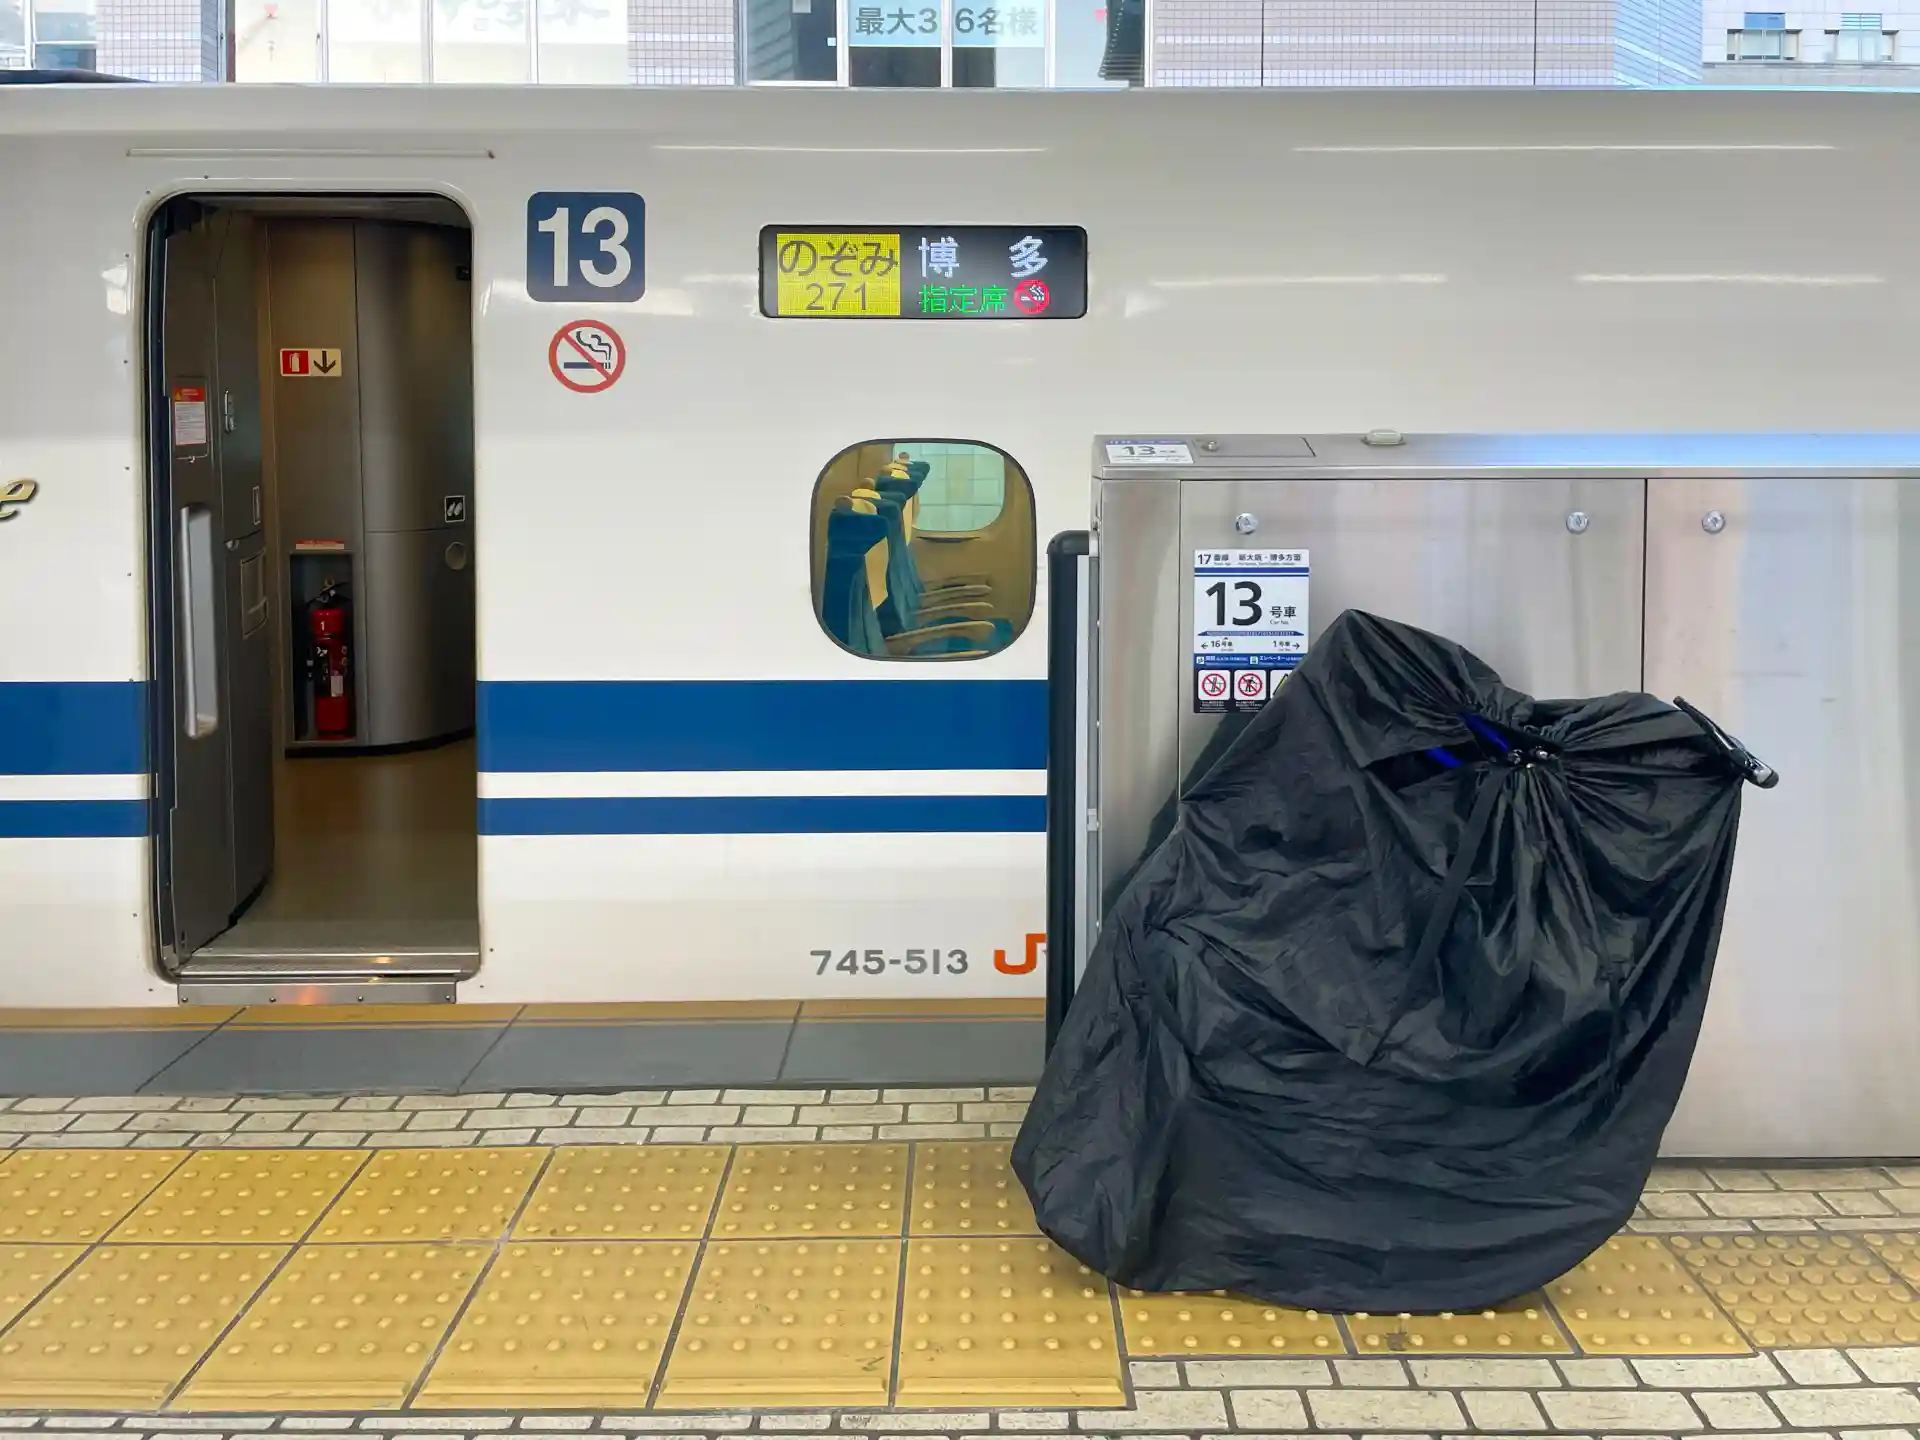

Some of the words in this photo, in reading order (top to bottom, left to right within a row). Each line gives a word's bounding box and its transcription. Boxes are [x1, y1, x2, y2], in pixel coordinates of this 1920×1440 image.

[538, 206, 632, 288] 13
[778, 238, 899, 277] のぞみ
[805, 282, 868, 312] 271
[918, 284, 1008, 314] 指定席
[1198, 554, 1211, 565] 17
[1205, 581, 1262, 626] 13
[1269, 606, 1297, 618] 号車
[1210, 640, 1221, 648] 16
[810, 949, 969, 976] 745-513
